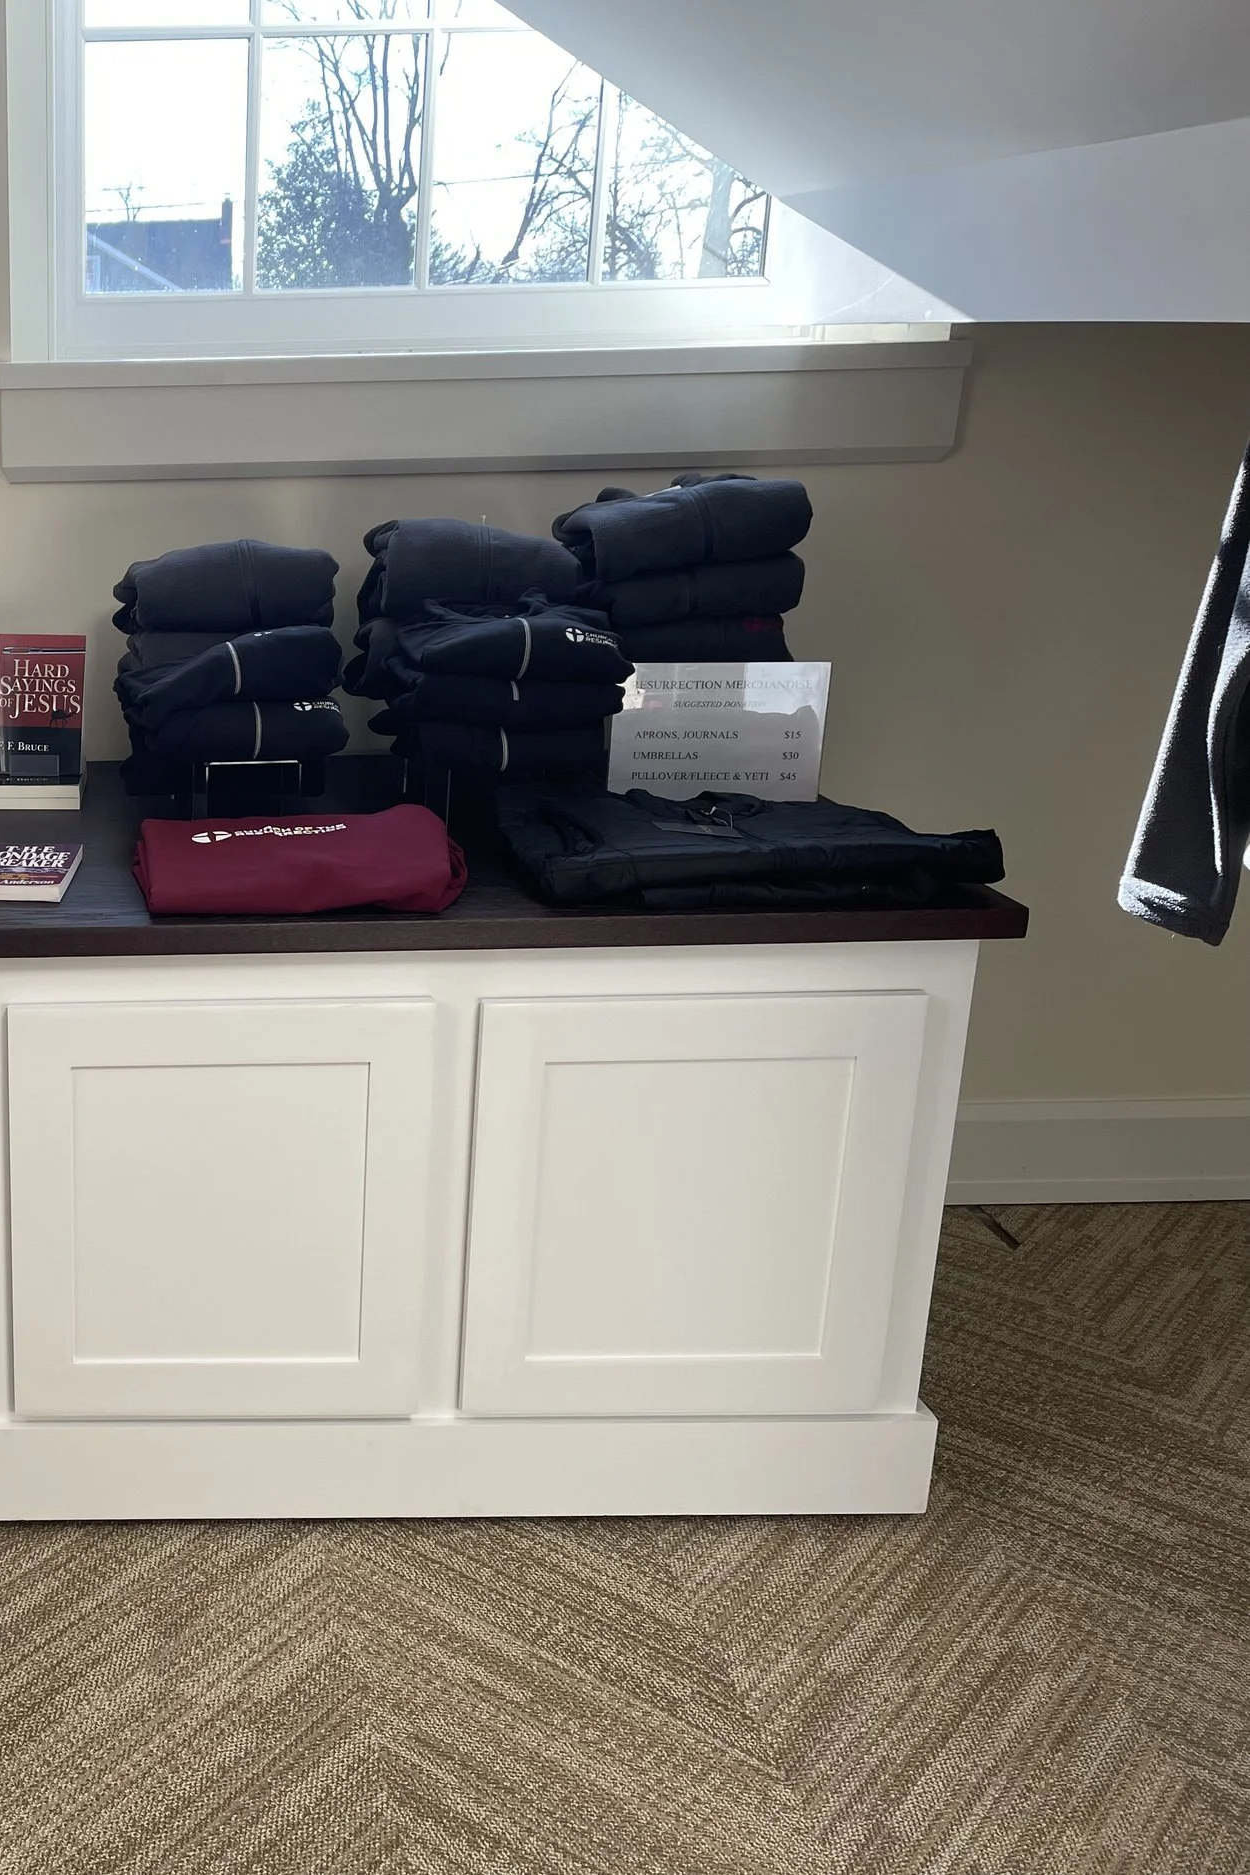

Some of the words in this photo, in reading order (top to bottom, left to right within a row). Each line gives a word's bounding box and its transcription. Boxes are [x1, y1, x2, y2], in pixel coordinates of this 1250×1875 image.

[13, 658, 70, 678] HARD
[0, 676, 77, 696] SAYINGS
[725, 680, 812, 690] MERCHANDISE
[0, 697, 13, 708] OF
[9, 693, 81, 719] JESUS
[674, 700, 722, 708] SUGGESTED
[634, 731, 680, 740] APRONS,
[682, 730, 739, 740] JOURNALS
[784, 730, 801, 740] $15
[7, 741, 15, 751] F.
[18, 742, 50, 752] BRUCE
[633, 752, 699, 760] UMBRELLAS
[782, 751, 800, 760] $30
[631, 772, 731, 781] PULLOVER/FLEECE
[733, 772, 741, 781] &
[744, 772, 769, 781] YETI
[780, 772, 797, 781] $45
